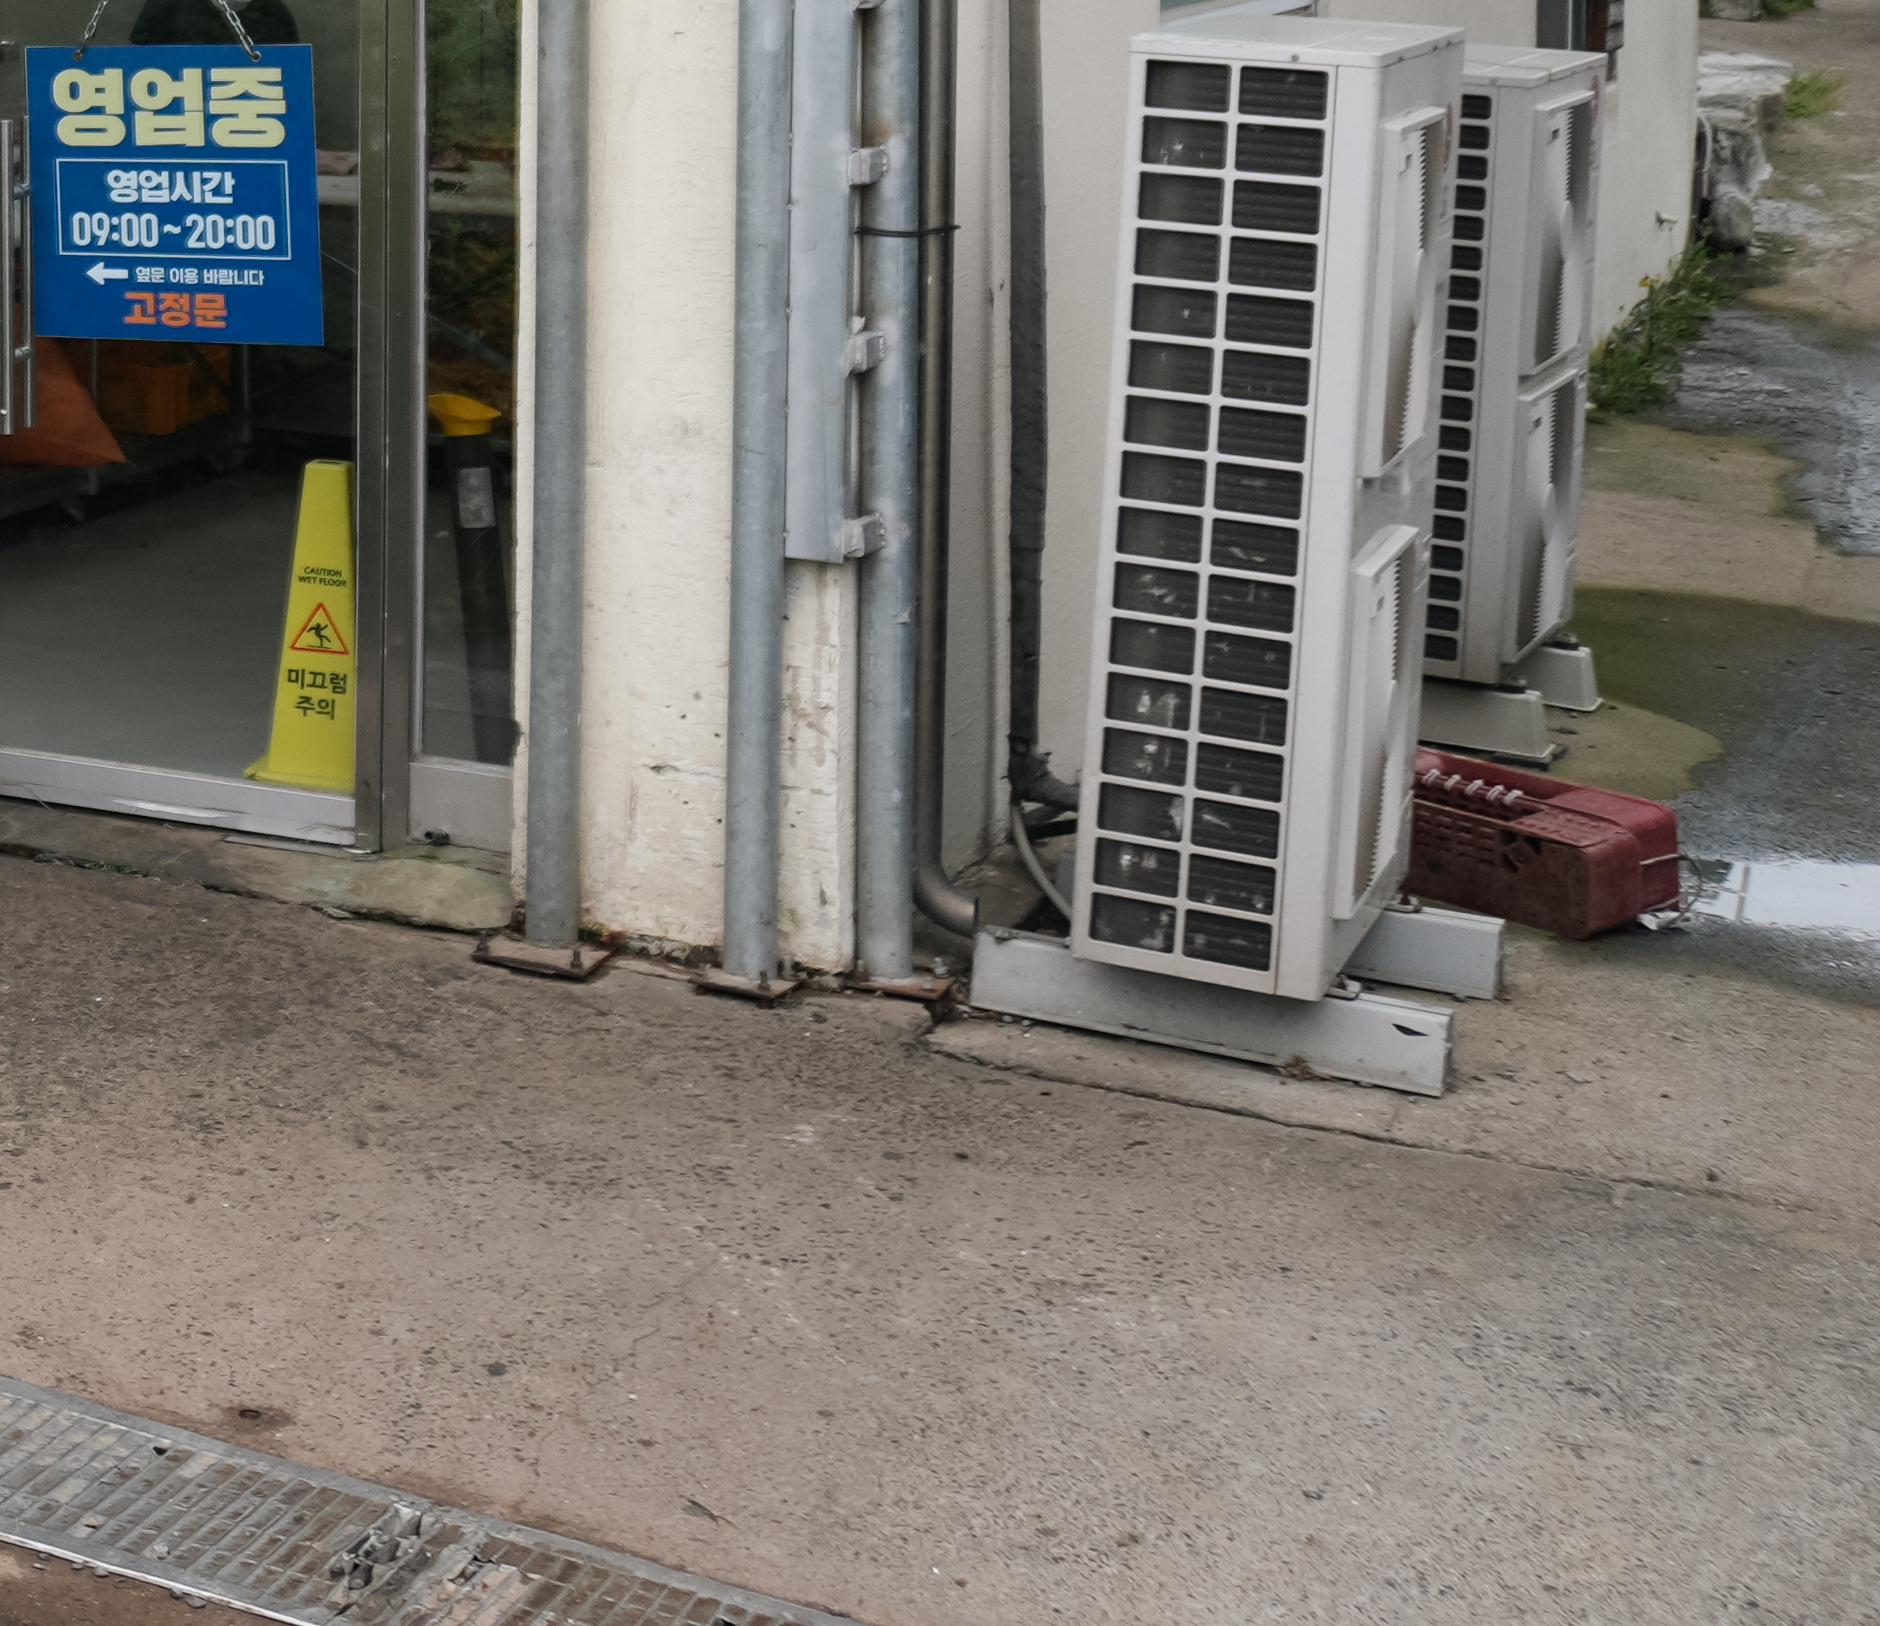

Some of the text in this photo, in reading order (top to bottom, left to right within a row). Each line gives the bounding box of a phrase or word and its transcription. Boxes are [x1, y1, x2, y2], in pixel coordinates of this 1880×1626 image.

[53, 67, 287, 148] 영업중
[107, 170, 235, 204] 영업시간
[169, 268, 199, 284] 이용
[203, 269, 265, 286] 바랍니다
[124, 291, 228, 328] 고정문
[298, 576, 347, 588] WET FLOOR
[304, 566, 342, 578] CAUTION
[287, 669, 348, 695] 미끄럼
[295, 695, 336, 721] 주의
